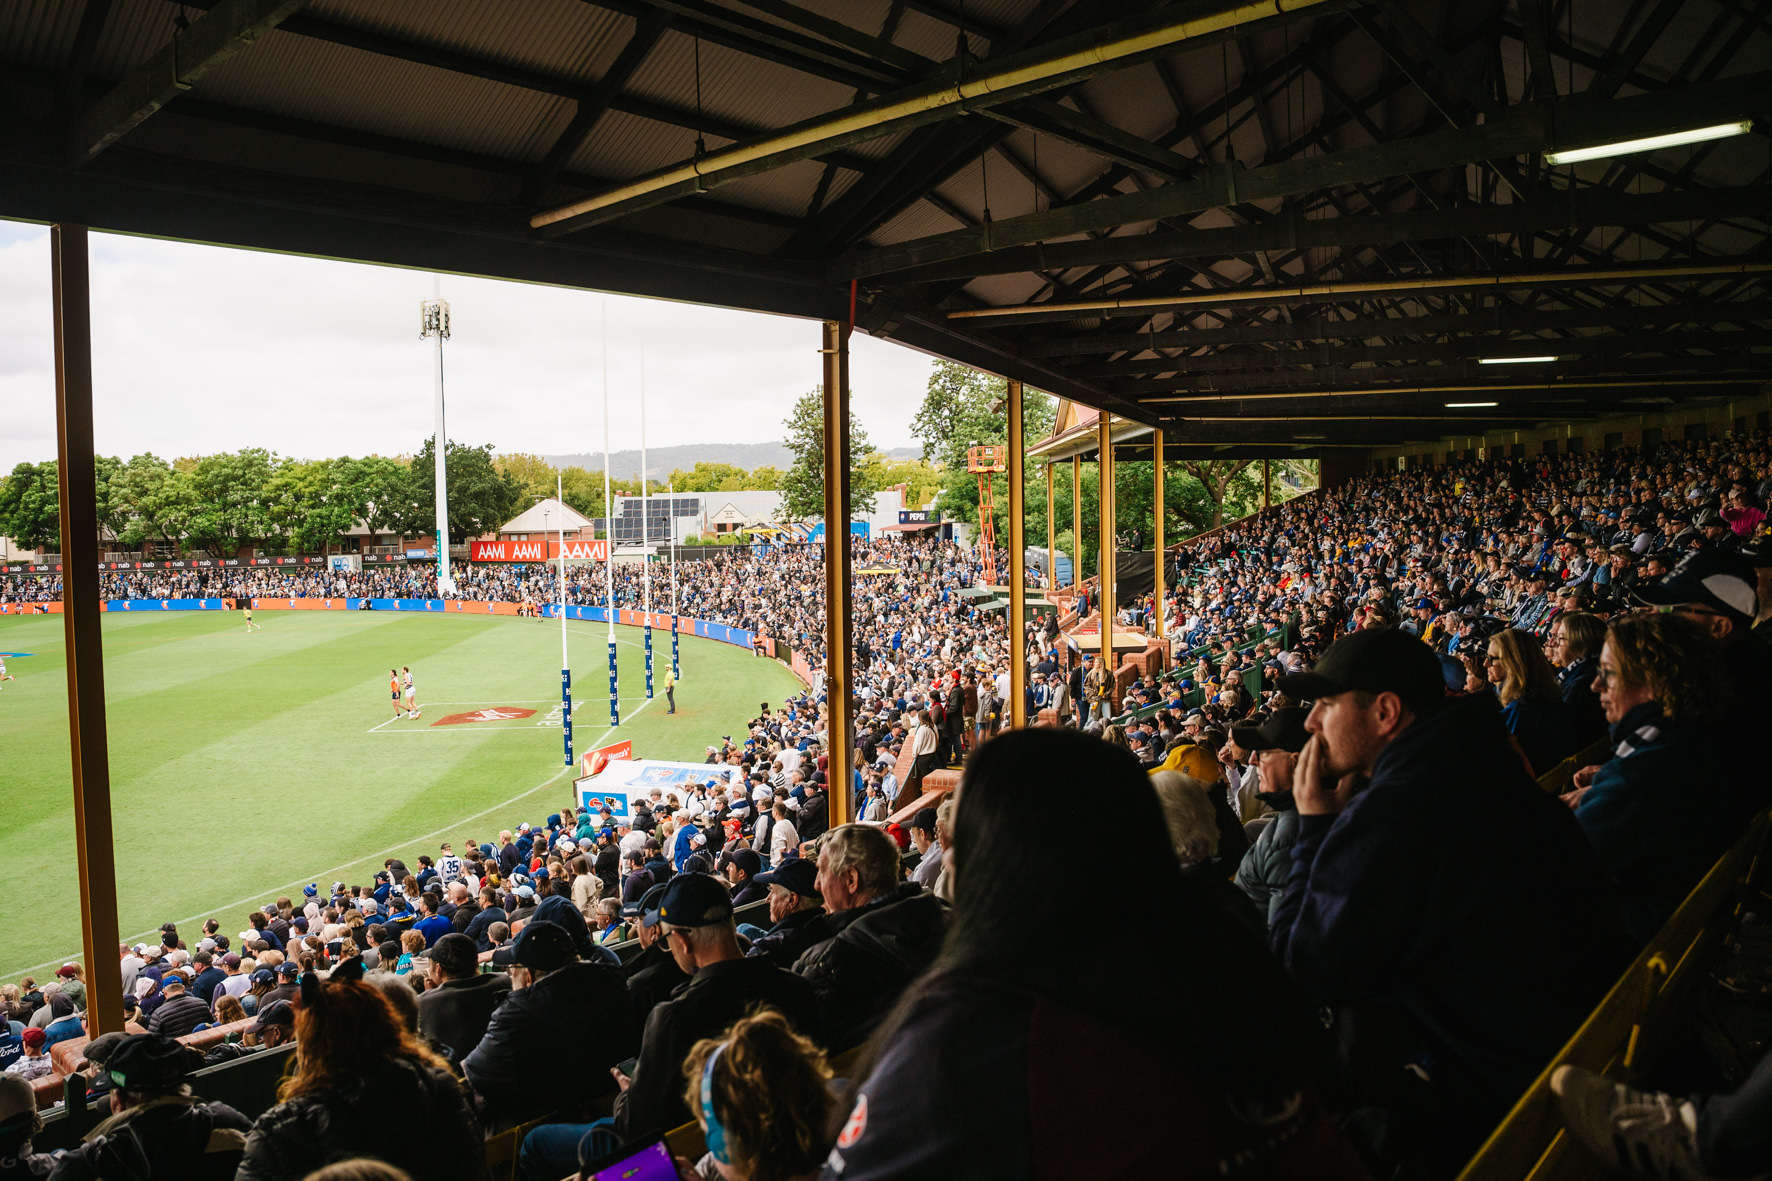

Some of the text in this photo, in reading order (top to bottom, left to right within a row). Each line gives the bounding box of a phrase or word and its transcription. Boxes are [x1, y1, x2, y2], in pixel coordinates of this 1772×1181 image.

[478, 543, 505, 559] AAMI
[512, 543, 541, 559] AAMI
[558, 542, 605, 559] AAMI
[36, 564, 49, 572] nab
[446, 860, 459, 873] 35
[0, 1044, 20, 1057] Ford
